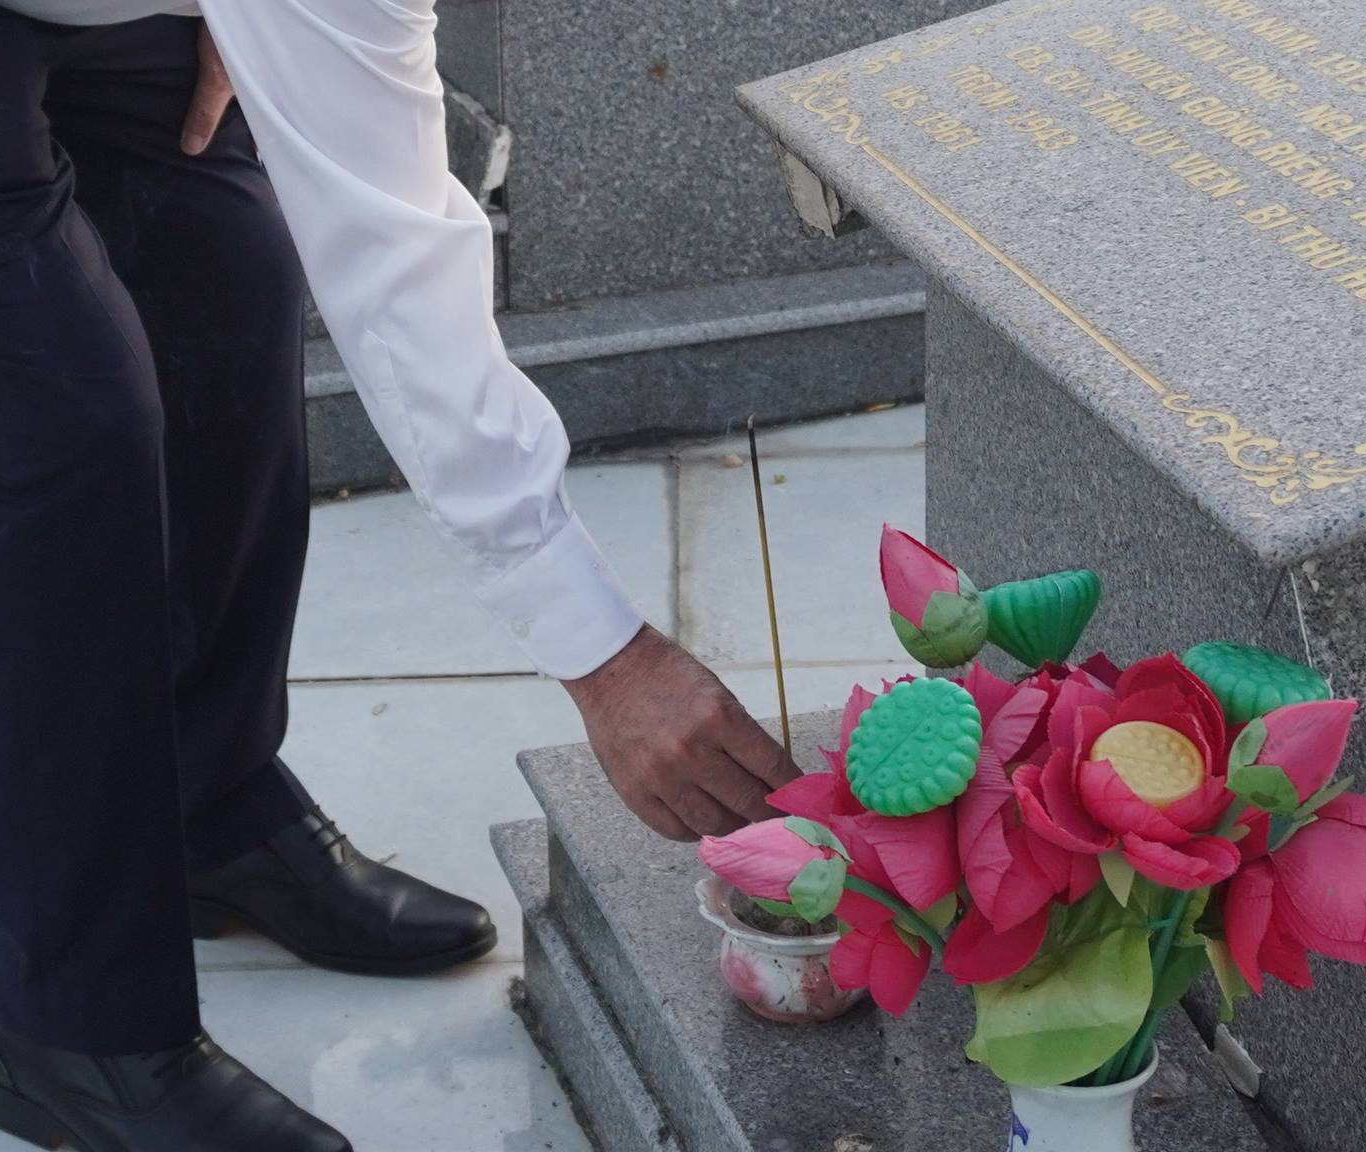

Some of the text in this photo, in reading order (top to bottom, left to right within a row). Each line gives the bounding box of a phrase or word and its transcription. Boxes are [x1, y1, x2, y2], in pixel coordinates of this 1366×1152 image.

[1217, 57, 1299, 103] LONG
[911, 111, 981, 152] 1961
[1004, 110, 1080, 152] 1943
[1170, 152, 1249, 200] VIÊN
[1242, 202, 1307, 233] BÍ
